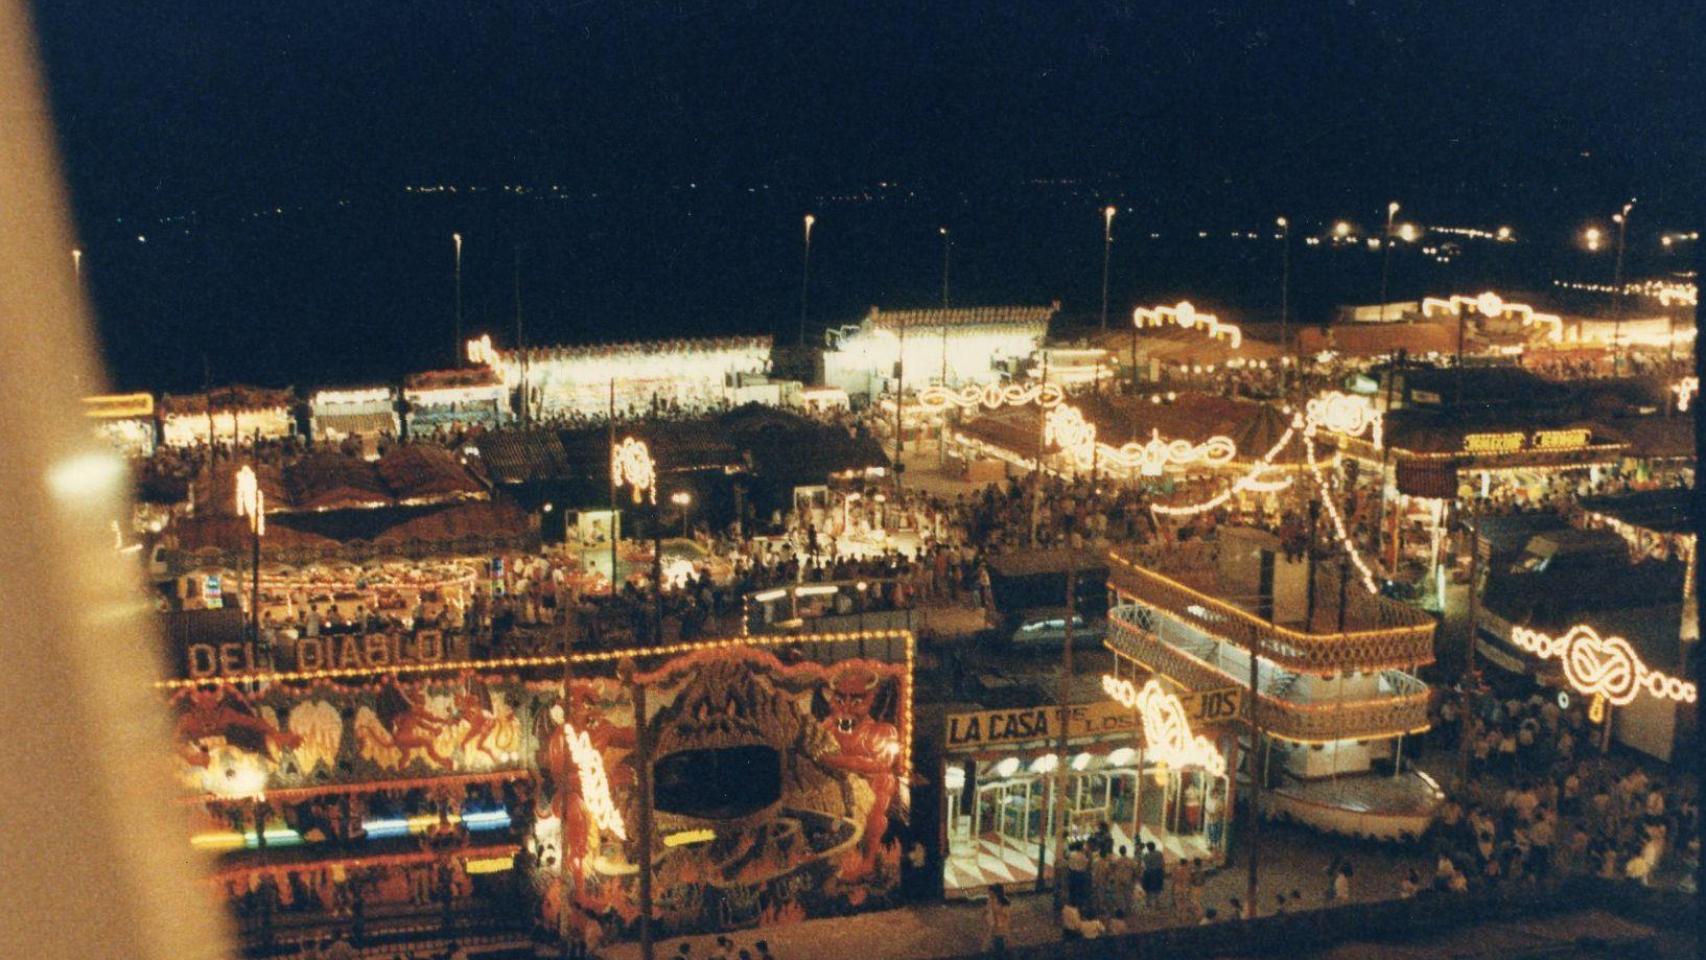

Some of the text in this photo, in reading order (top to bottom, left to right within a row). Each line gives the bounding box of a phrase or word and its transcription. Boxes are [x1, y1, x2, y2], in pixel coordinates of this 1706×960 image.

[188, 631, 442, 678] DEL DIABLO
[950, 717, 981, 743] LA
[989, 710, 1049, 739] CASA
